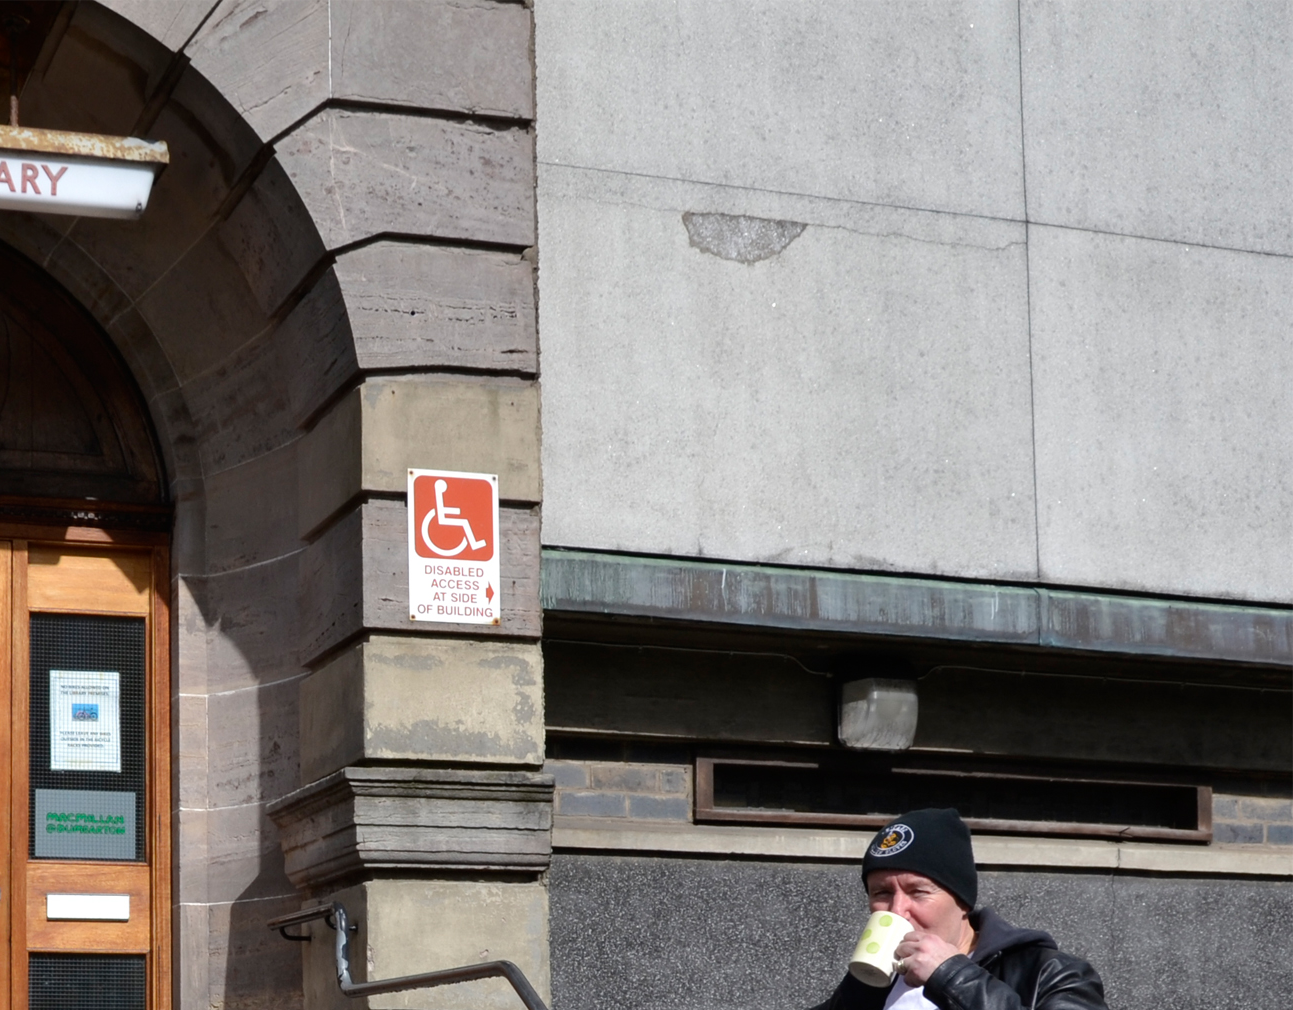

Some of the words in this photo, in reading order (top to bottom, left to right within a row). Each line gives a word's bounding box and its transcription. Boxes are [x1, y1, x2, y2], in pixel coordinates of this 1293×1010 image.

[424, 564, 484, 578] DISABLED
[431, 578, 480, 591] ACCESS
[433, 591, 447, 602] AT
[450, 592, 478, 604] SIDE
[417, 603, 433, 614] OF
[437, 605, 493, 618] BUILDING
[46, 812, 125, 824] MACMILLAN
[46, 823, 126, 835] @DUMBARTON
